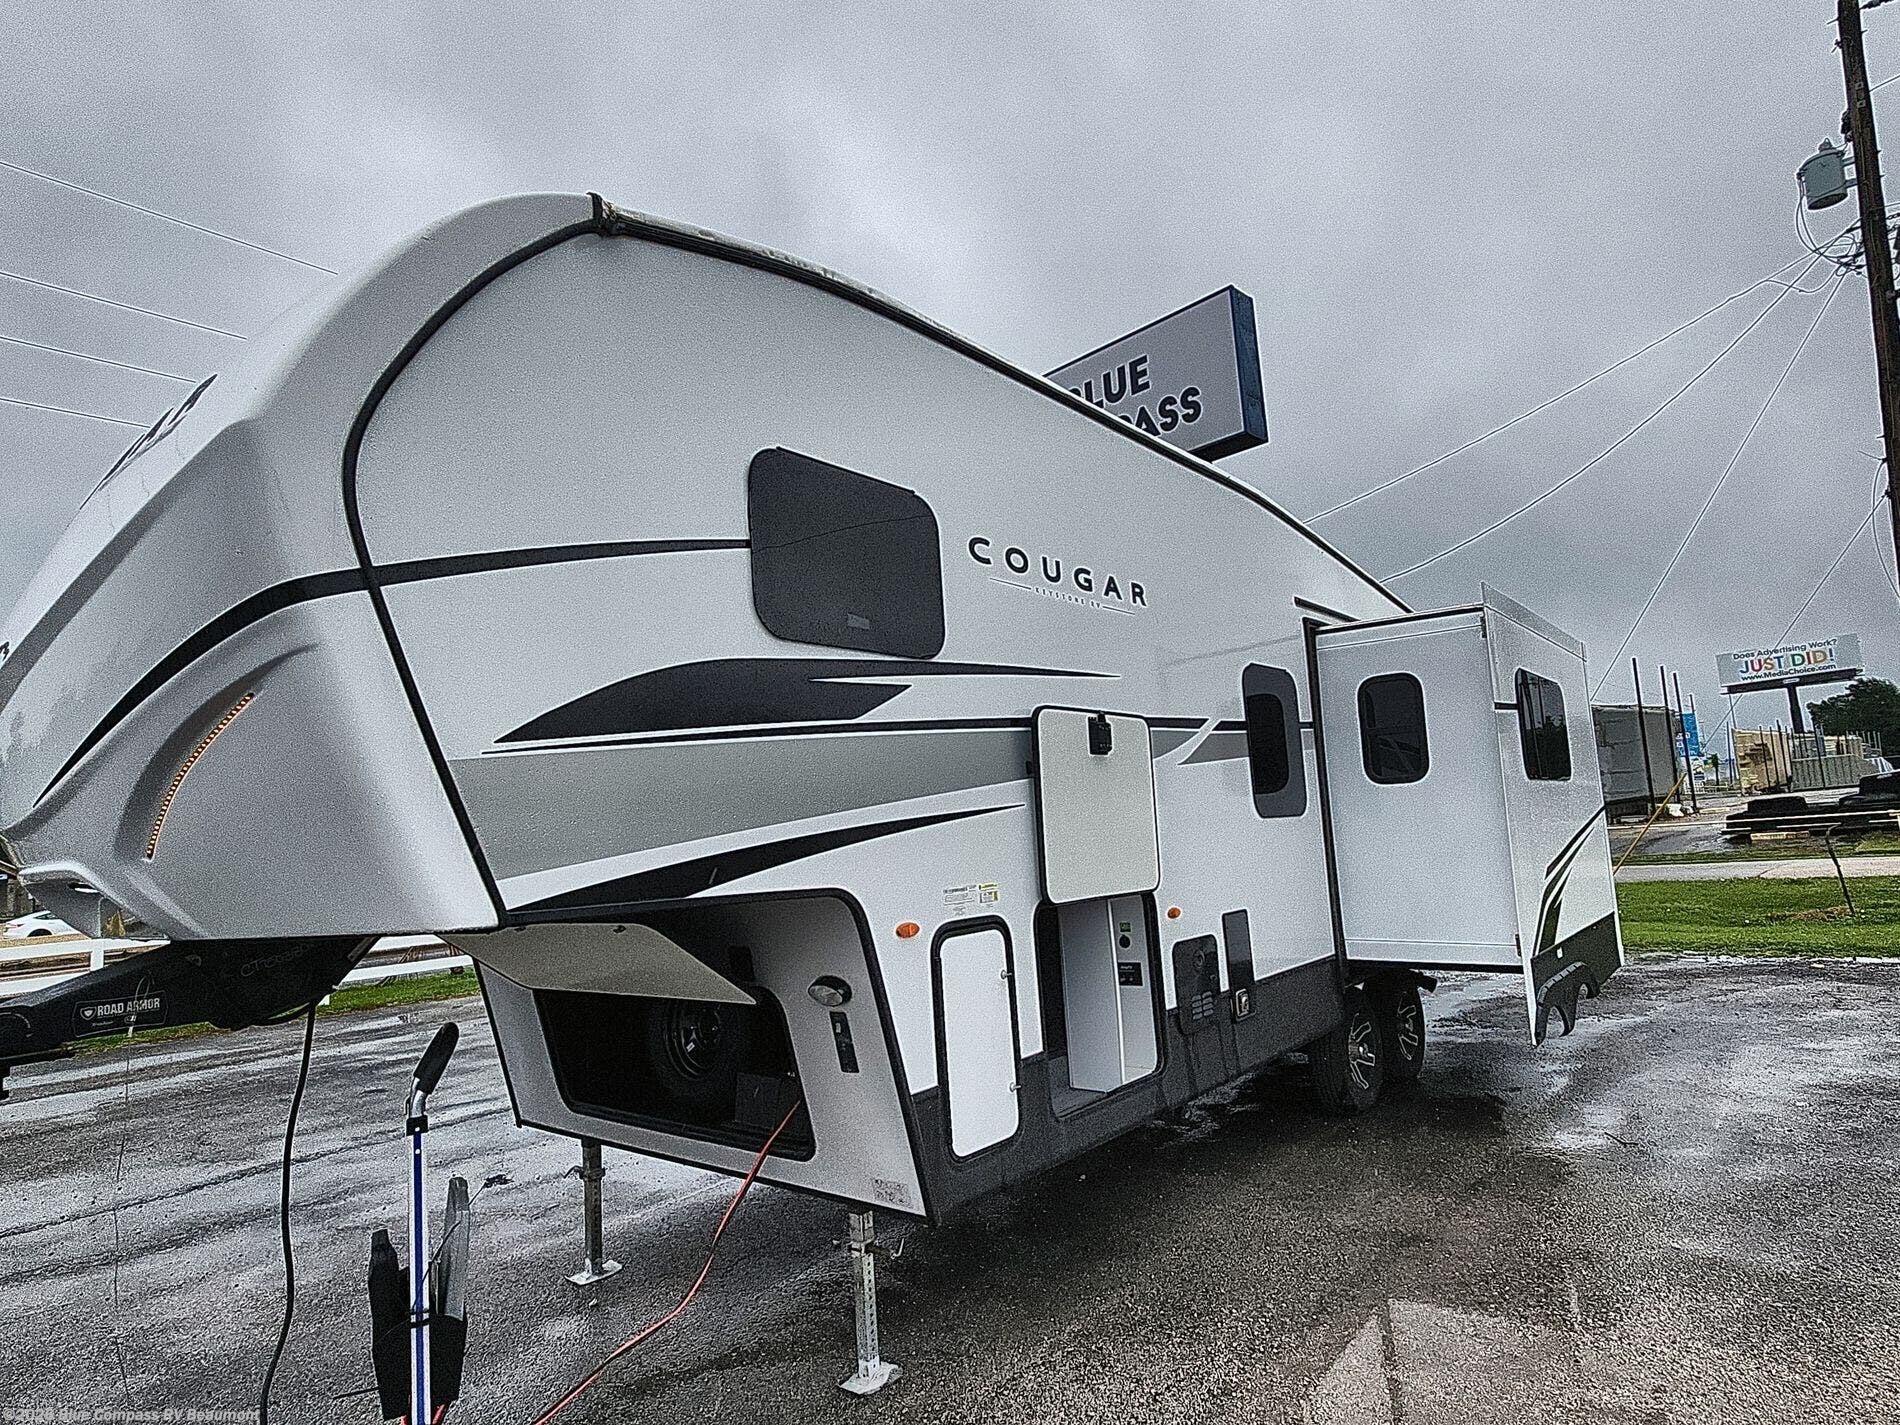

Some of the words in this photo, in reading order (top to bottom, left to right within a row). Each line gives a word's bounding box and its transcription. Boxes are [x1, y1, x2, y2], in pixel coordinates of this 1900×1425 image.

[968, 537, 1147, 606] COUGAR
[1035, 587, 1086, 606] KEYSTONE
[1733, 652, 1755, 660] Does
[1756, 644, 1807, 657] Advertising
[1808, 639, 1837, 649] Work?
[1740, 656, 1784, 674] JUST
[1791, 648, 1834, 667] DID!
[1741, 664, 1837, 681] www.MediaChoice.com
[97, 1002, 124, 1016] ROAD
[126, 998, 160, 1012] ARMOR
